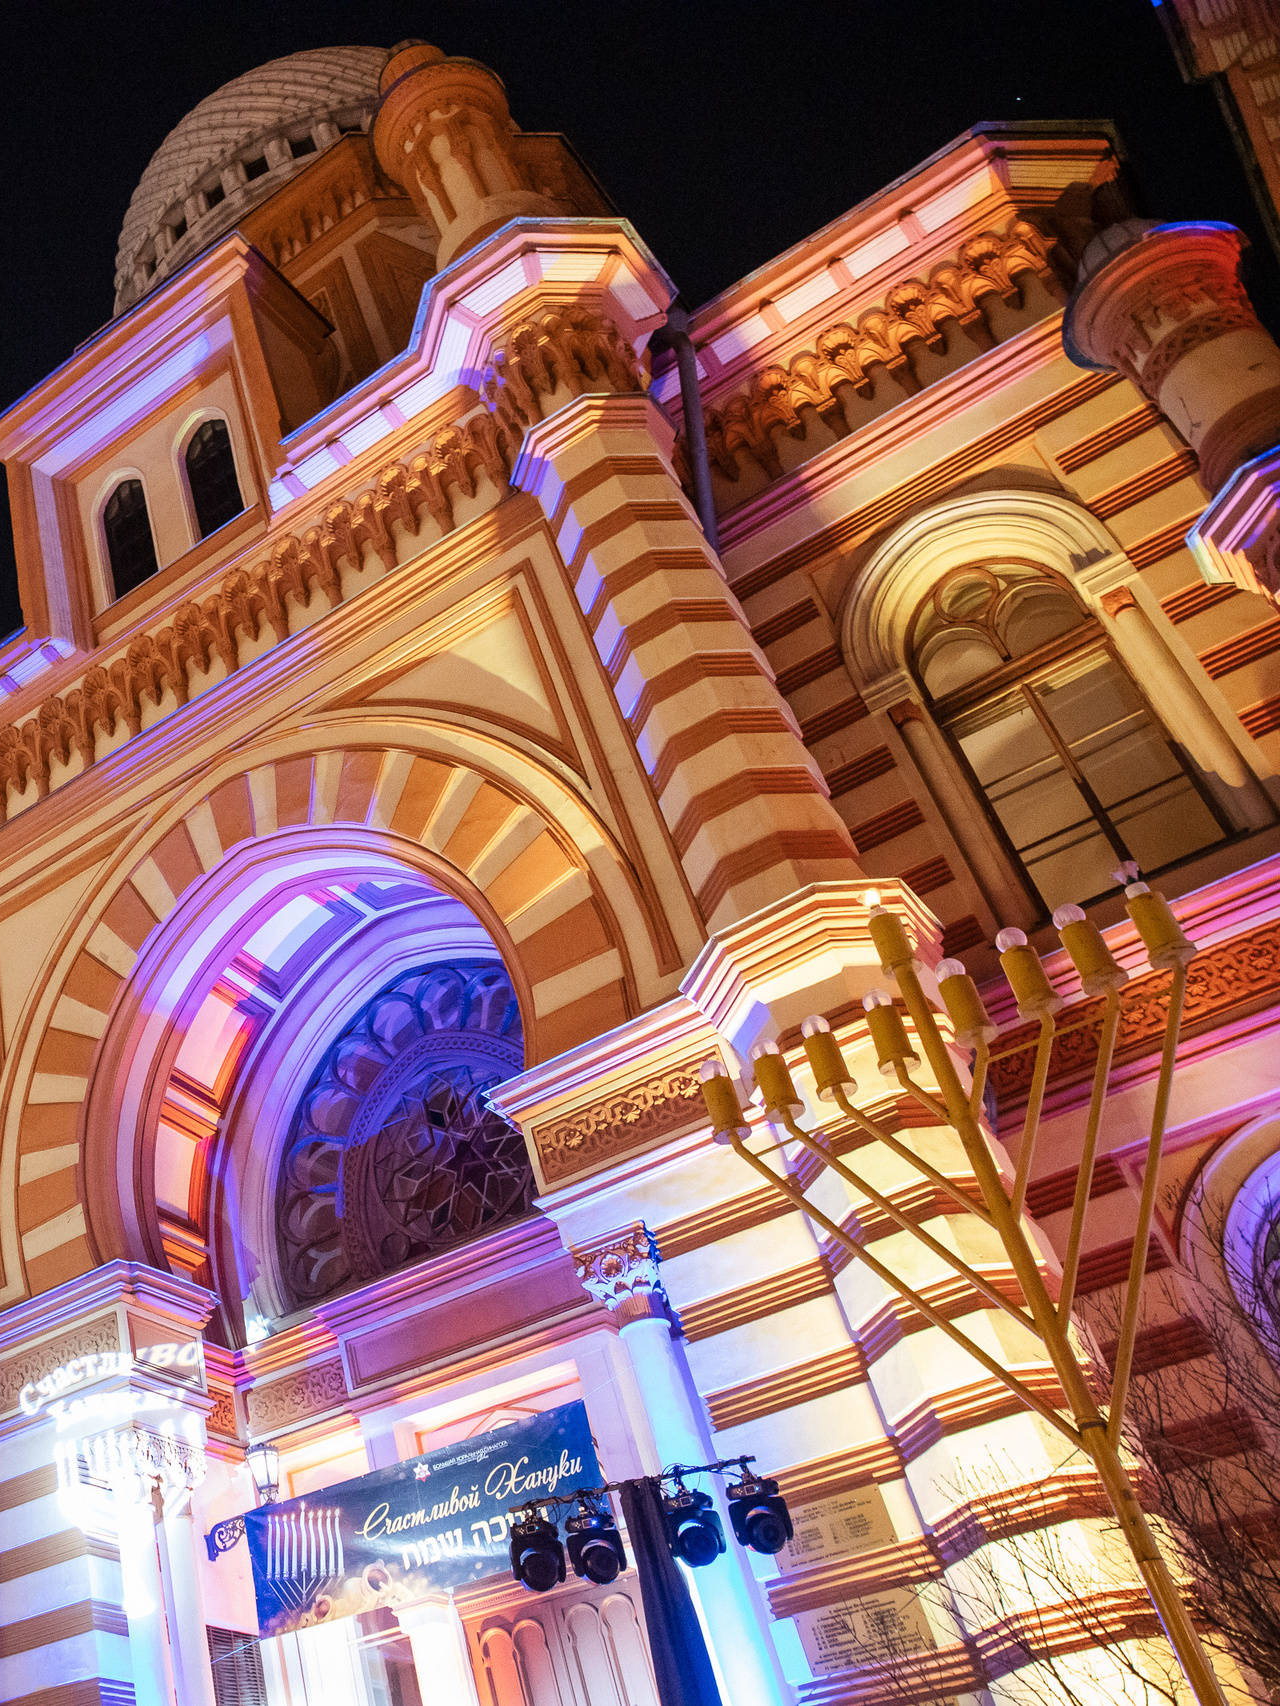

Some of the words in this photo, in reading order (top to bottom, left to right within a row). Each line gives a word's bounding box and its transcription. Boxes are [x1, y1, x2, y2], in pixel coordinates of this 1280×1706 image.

[354, 1484, 481, 1541] Счастливой
[484, 1449, 582, 1500] Хануки
[400, 1527, 464, 1571] שמח
